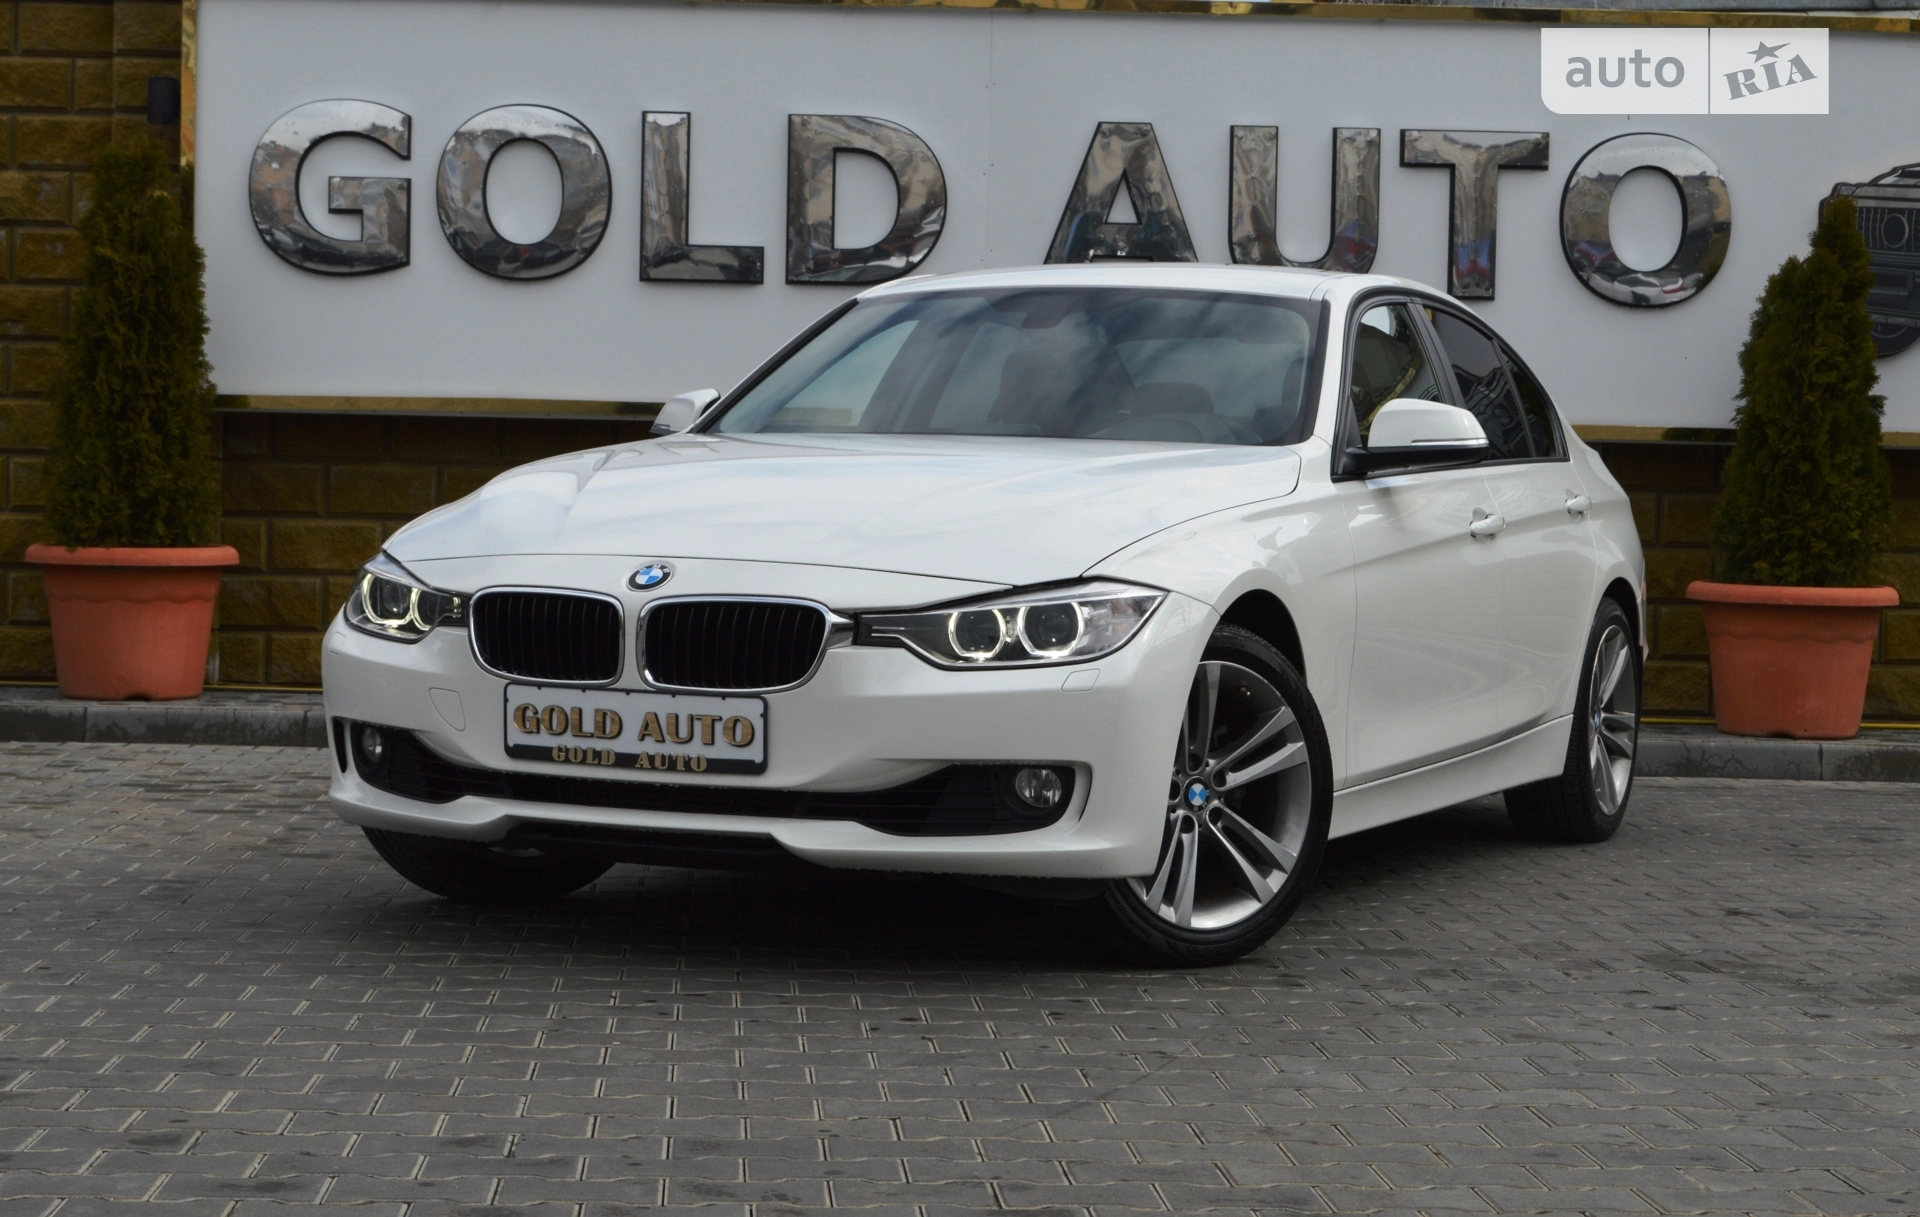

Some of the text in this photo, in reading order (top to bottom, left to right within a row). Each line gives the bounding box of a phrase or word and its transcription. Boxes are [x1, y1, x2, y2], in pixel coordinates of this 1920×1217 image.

[249, 99, 1733, 308] GOLD AUTO
[513, 702, 756, 747] GOLD AUTO
[552, 745, 708, 772] GOLD AUTO
